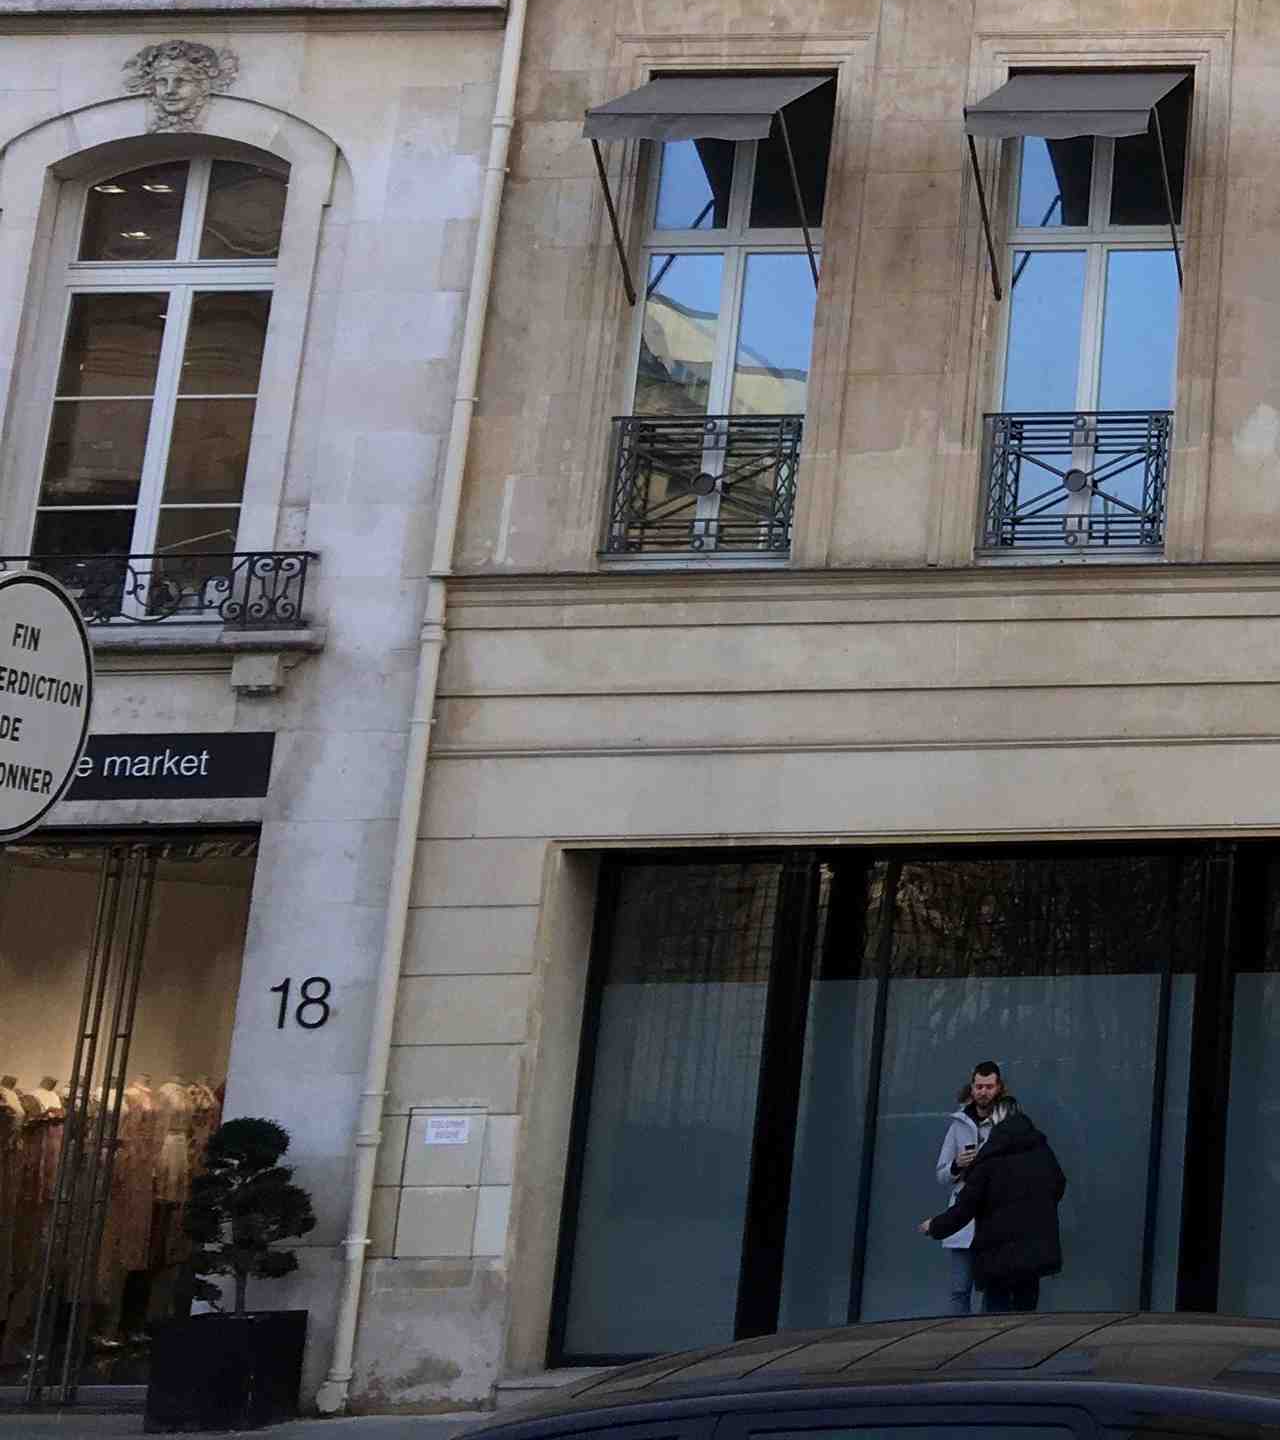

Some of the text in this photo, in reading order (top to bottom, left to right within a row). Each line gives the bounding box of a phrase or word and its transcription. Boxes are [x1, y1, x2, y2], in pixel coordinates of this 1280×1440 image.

[12, 623, 41, 651] FIN
[0, 714, 23, 742] DE
[103, 749, 210, 776] market
[270, 977, 332, 1030] 18
